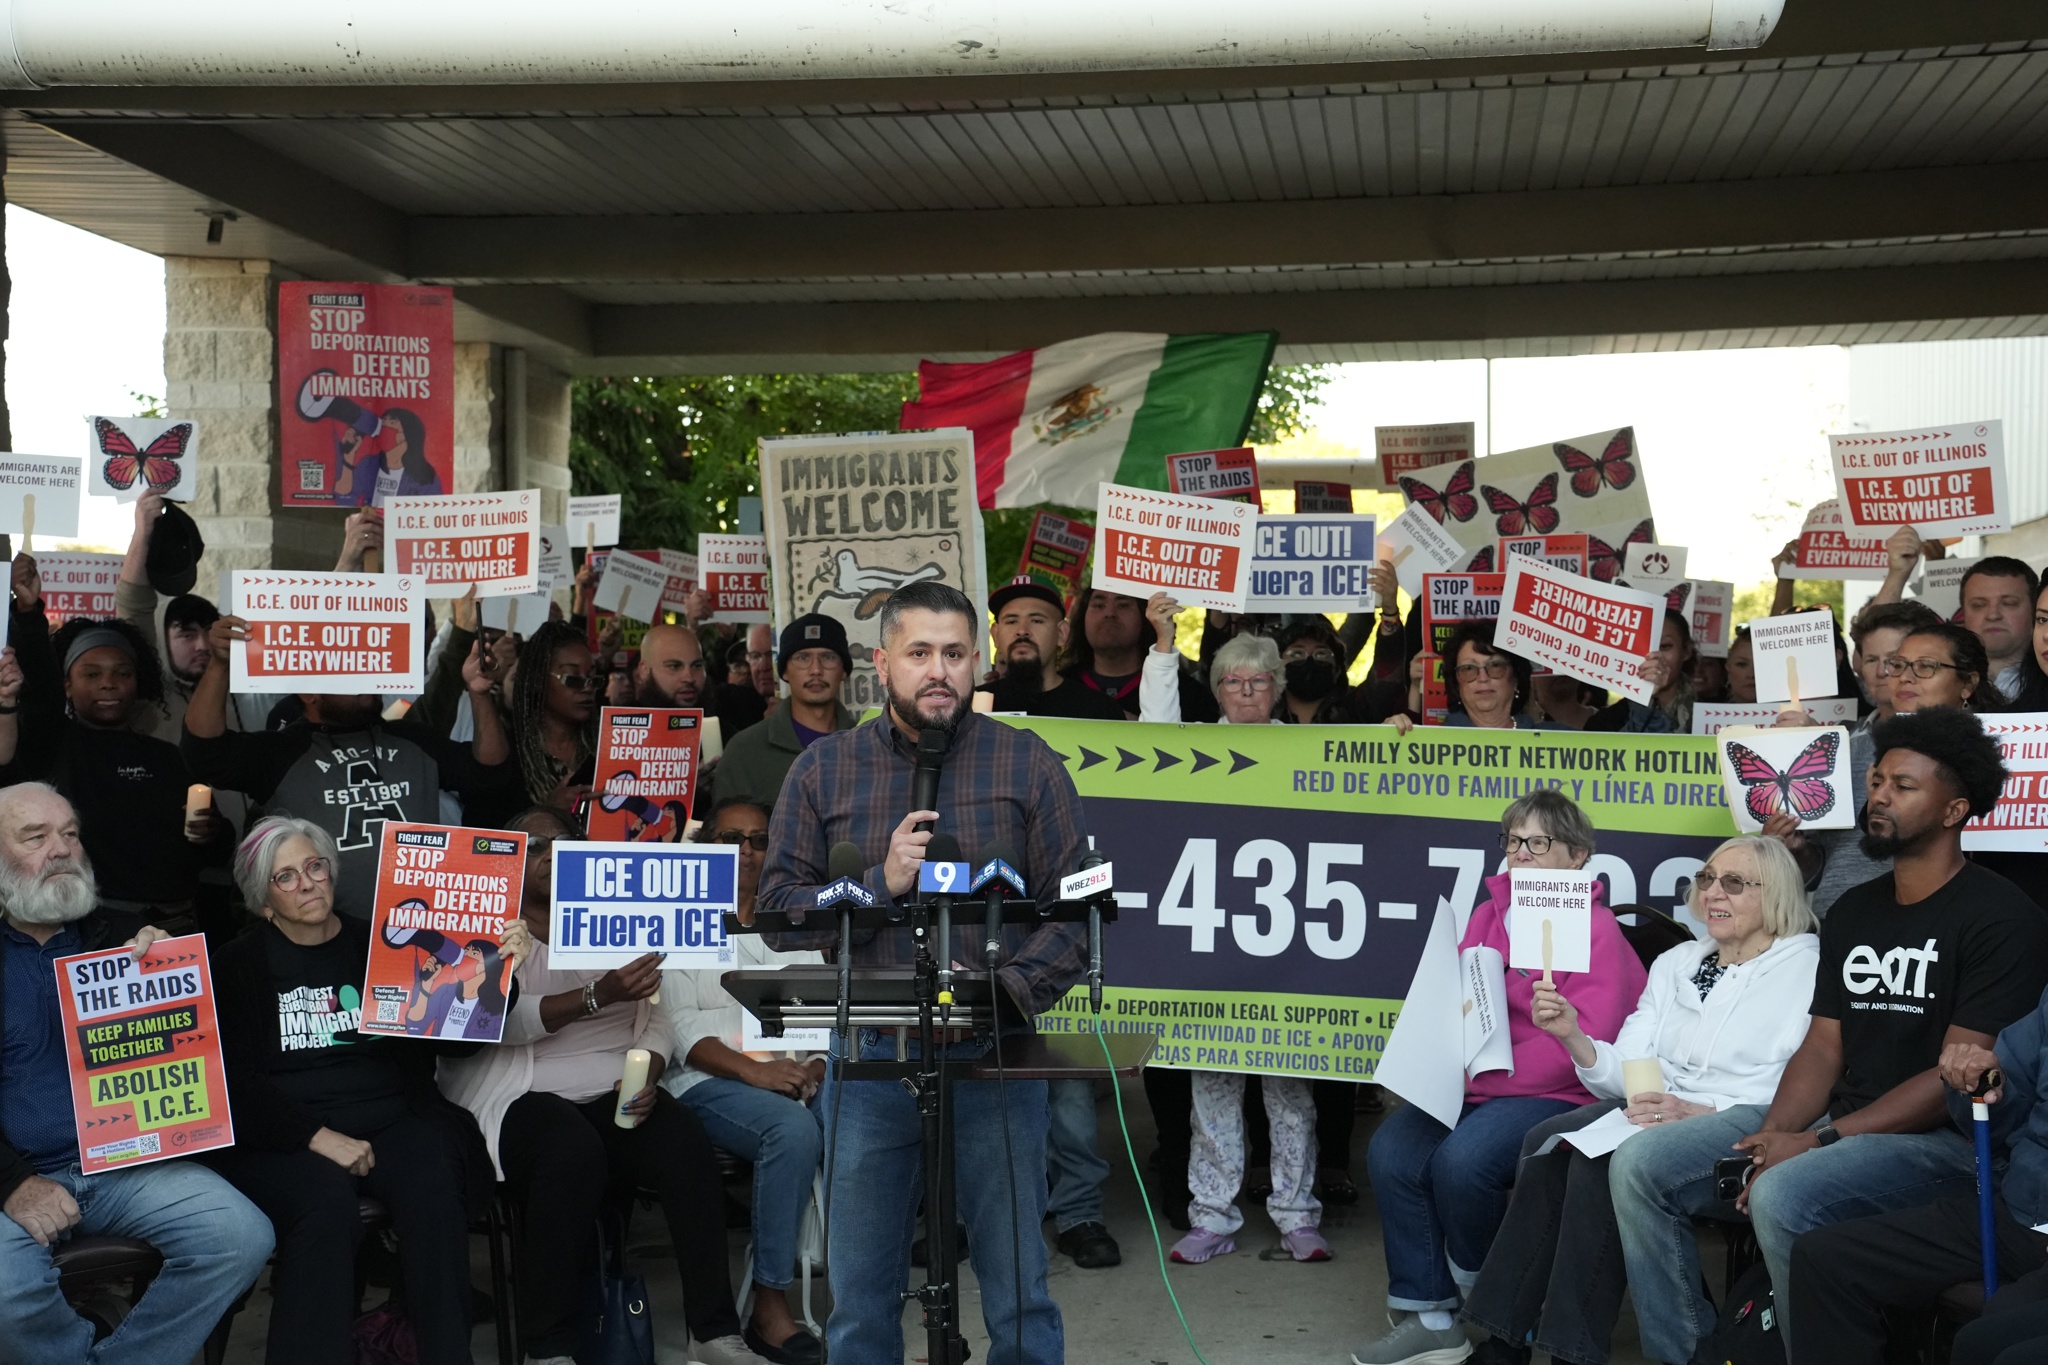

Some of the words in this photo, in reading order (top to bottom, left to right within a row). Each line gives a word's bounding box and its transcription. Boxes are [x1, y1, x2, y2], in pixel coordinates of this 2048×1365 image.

[312, 295, 336, 305] FIGHT
[338, 296, 359, 306] FEAR
[310, 309, 365, 332] STOP
[311, 333, 430, 354] DEPORTATIONS
[353, 353, 430, 378] DEFEND
[311, 375, 430, 399] IMMIGRANTS
[1178, 457, 1212, 474] STOP
[1842, 454, 1870, 468] I.C.E.
[1873, 452, 1898, 467] OUT
[1903, 450, 1920, 466] OF
[1925, 443, 1987, 463] ILLINOIS
[60, 466, 81, 475] ARE
[780, 447, 960, 492] IMMIGRANTS
[49, 479, 76, 488] HERE
[1180, 475, 1206, 492] THE
[1210, 471, 1251, 489] RAIDS
[1858, 480, 1898, 500] I.C.E.
[1903, 476, 1941, 499] OUT
[1947, 473, 1972, 494] OF
[397, 516, 430, 529] I.C.E.
[434, 515, 458, 528] OUT
[462, 514, 477, 528] OF
[481, 510, 528, 526] ILLINOIS
[782, 487, 960, 537] WELCOME
[1860, 495, 1976, 522] EVERYWHERE
[1108, 505, 1134, 522] I.C.E.
[1138, 510, 1163, 526] OUT
[1166, 515, 1182, 530] OF
[1185, 517, 1241, 537] ILLINOIS
[1294, 525, 1351, 558] OUT!
[1401, 518, 1433, 550] WELCOME
[1430, 548, 1448, 567] HERE
[1407, 509, 1446, 549] IMMIGRANTS
[1444, 547, 1459, 562] ARE
[1809, 533, 1845, 549] I.C.E.
[411, 541, 455, 560] I.C.E.
[460, 539, 492, 558] OUT
[497, 537, 516, 555] OF
[707, 552, 733, 565] I.C.E.
[737, 553, 758, 565] OUT
[1117, 534, 1154, 559] I.C.E.
[1159, 541, 1196, 563] OUT
[1199, 547, 1223, 567] OF
[1509, 542, 1541, 556] STOP
[1806, 551, 1889, 568] EVERYWHER
[67, 572, 91, 584] OUT
[95, 573, 109, 584] OF
[411, 558, 517, 580] EVERYWHERE
[1116, 556, 1221, 590] EVERYWHERE
[718, 575, 756, 591] I.C.E.
[1252, 570, 1314, 596] uera
[1322, 565, 1368, 596] ICE!
[1434, 579, 1469, 595] STOP
[47, 594, 87, 611] I.C.E.
[246, 594, 284, 610] I.C.E.
[290, 594, 319, 610] OUT
[325, 596, 342, 611] OF
[347, 596, 408, 612] ILLINOIS
[1433, 599, 1458, 615] THE
[1463, 600, 1500, 616] RAID
[1529, 599, 1550, 620] OF
[1532, 577, 1642, 630] EVERYWHERE
[1553, 608, 1587, 634] OUT
[1754, 622, 1812, 638] IMMIGRANTS
[1814, 620, 1831, 631] ARE
[264, 625, 315, 646] I.C.E.
[322, 625, 361, 647] OUT
[367, 627, 391, 647] OF
[1509, 620, 1563, 651] CHICAGO
[1593, 621, 1636, 650] I.C.E.
[1759, 638, 1804, 651] WELCOME
[1806, 634, 1828, 645] HERE
[263, 650, 392, 672] EVERYWHERE
[1565, 643, 1581, 657] OF
[1583, 650, 1609, 668] OUT
[612, 716, 631, 725] FIGHT
[632, 717, 648, 725] FEAR
[611, 728, 649, 745] STOP
[609, 746, 691, 761] DEPORTATIONS
[1324, 740, 1400, 764] FAMILY
[1408, 742, 1511, 767] SUPPORT
[1519, 746, 1627, 772] NETWORK
[1635, 749, 1721, 775] HOTLIN
[640, 761, 690, 778] DEFEND
[605, 779, 689, 796] IMMIGRANTS
[1293, 769, 1335, 793] RED
[1343, 771, 1369, 794] DE
[1376, 772, 1450, 796] APOYO
[1571, 779, 1584, 802] Y
[1592, 773, 1655, 804] LÍNEA
[1664, 782, 1731, 808] DIREC
[398, 833, 423, 844] FIGHT
[424, 834, 443, 846] FEAR
[395, 848, 445, 869] STOP
[984, 862, 996, 876] 5
[393, 868, 508, 893] DEPORTATIONS
[585, 857, 632, 898] ICE
[642, 858, 709, 899] OUT!
[933, 862, 957, 893] 9
[1014, 873, 1025, 889] 5
[1514, 880, 1570, 893] IMMIGRANTS
[1572, 882, 1590, 894] ARE
[434, 889, 507, 914] DEFEND
[817, 886, 835, 903] FOX
[834, 881, 845, 894] 32
[847, 881, 864, 899] FOX
[863, 891, 873, 904] 32
[1517, 896, 1560, 909] WELCOME
[1563, 898, 1586, 909] HERE
[388, 907, 505, 936] IMMIGRANTS
[674, 907, 728, 948] ICE!
[76, 956, 131, 985] STOP
[77, 985, 121, 1013] THE
[127, 972, 197, 1004] RAIDS
[374, 986, 395, 994] Defend
[1469, 962, 1483, 1011] WELCOME
[1473, 951, 1489, 1013] IMMIGRANTS
[278, 985, 333, 1004] SOUTWEST
[278, 998, 330, 1013] SUBUBAN
[1118, 998, 1225, 1019] DEPORTATION
[1231, 1003, 1278, 1022] LEGAL
[1284, 1005, 1360, 1027] SUPPORT
[1871, 1002, 1888, 1011] AND
[87, 1024, 123, 1044] KEEP
[127, 1011, 193, 1037] FAMILIES
[279, 1006, 360, 1036] IMMIGRA
[280, 1033, 333, 1052] PROJECT
[1034, 1015, 1071, 1032] ORTE
[1171, 1023, 1256, 1044] ACTIVIDAD
[1262, 1027, 1281, 1045] DE
[1287, 1029, 1312, 1047] ICE
[1332, 1032, 1385, 1052] APOYO
[90, 1036, 165, 1064] TOGETHER
[1196, 1047, 1239, 1065] PARA
[1244, 1049, 1330, 1072] SERVICIOS
[98, 1060, 200, 1102] ABOLISH
[143, 1091, 203, 1123] I.C.E.
[120, 1140, 136, 1148] Rights
